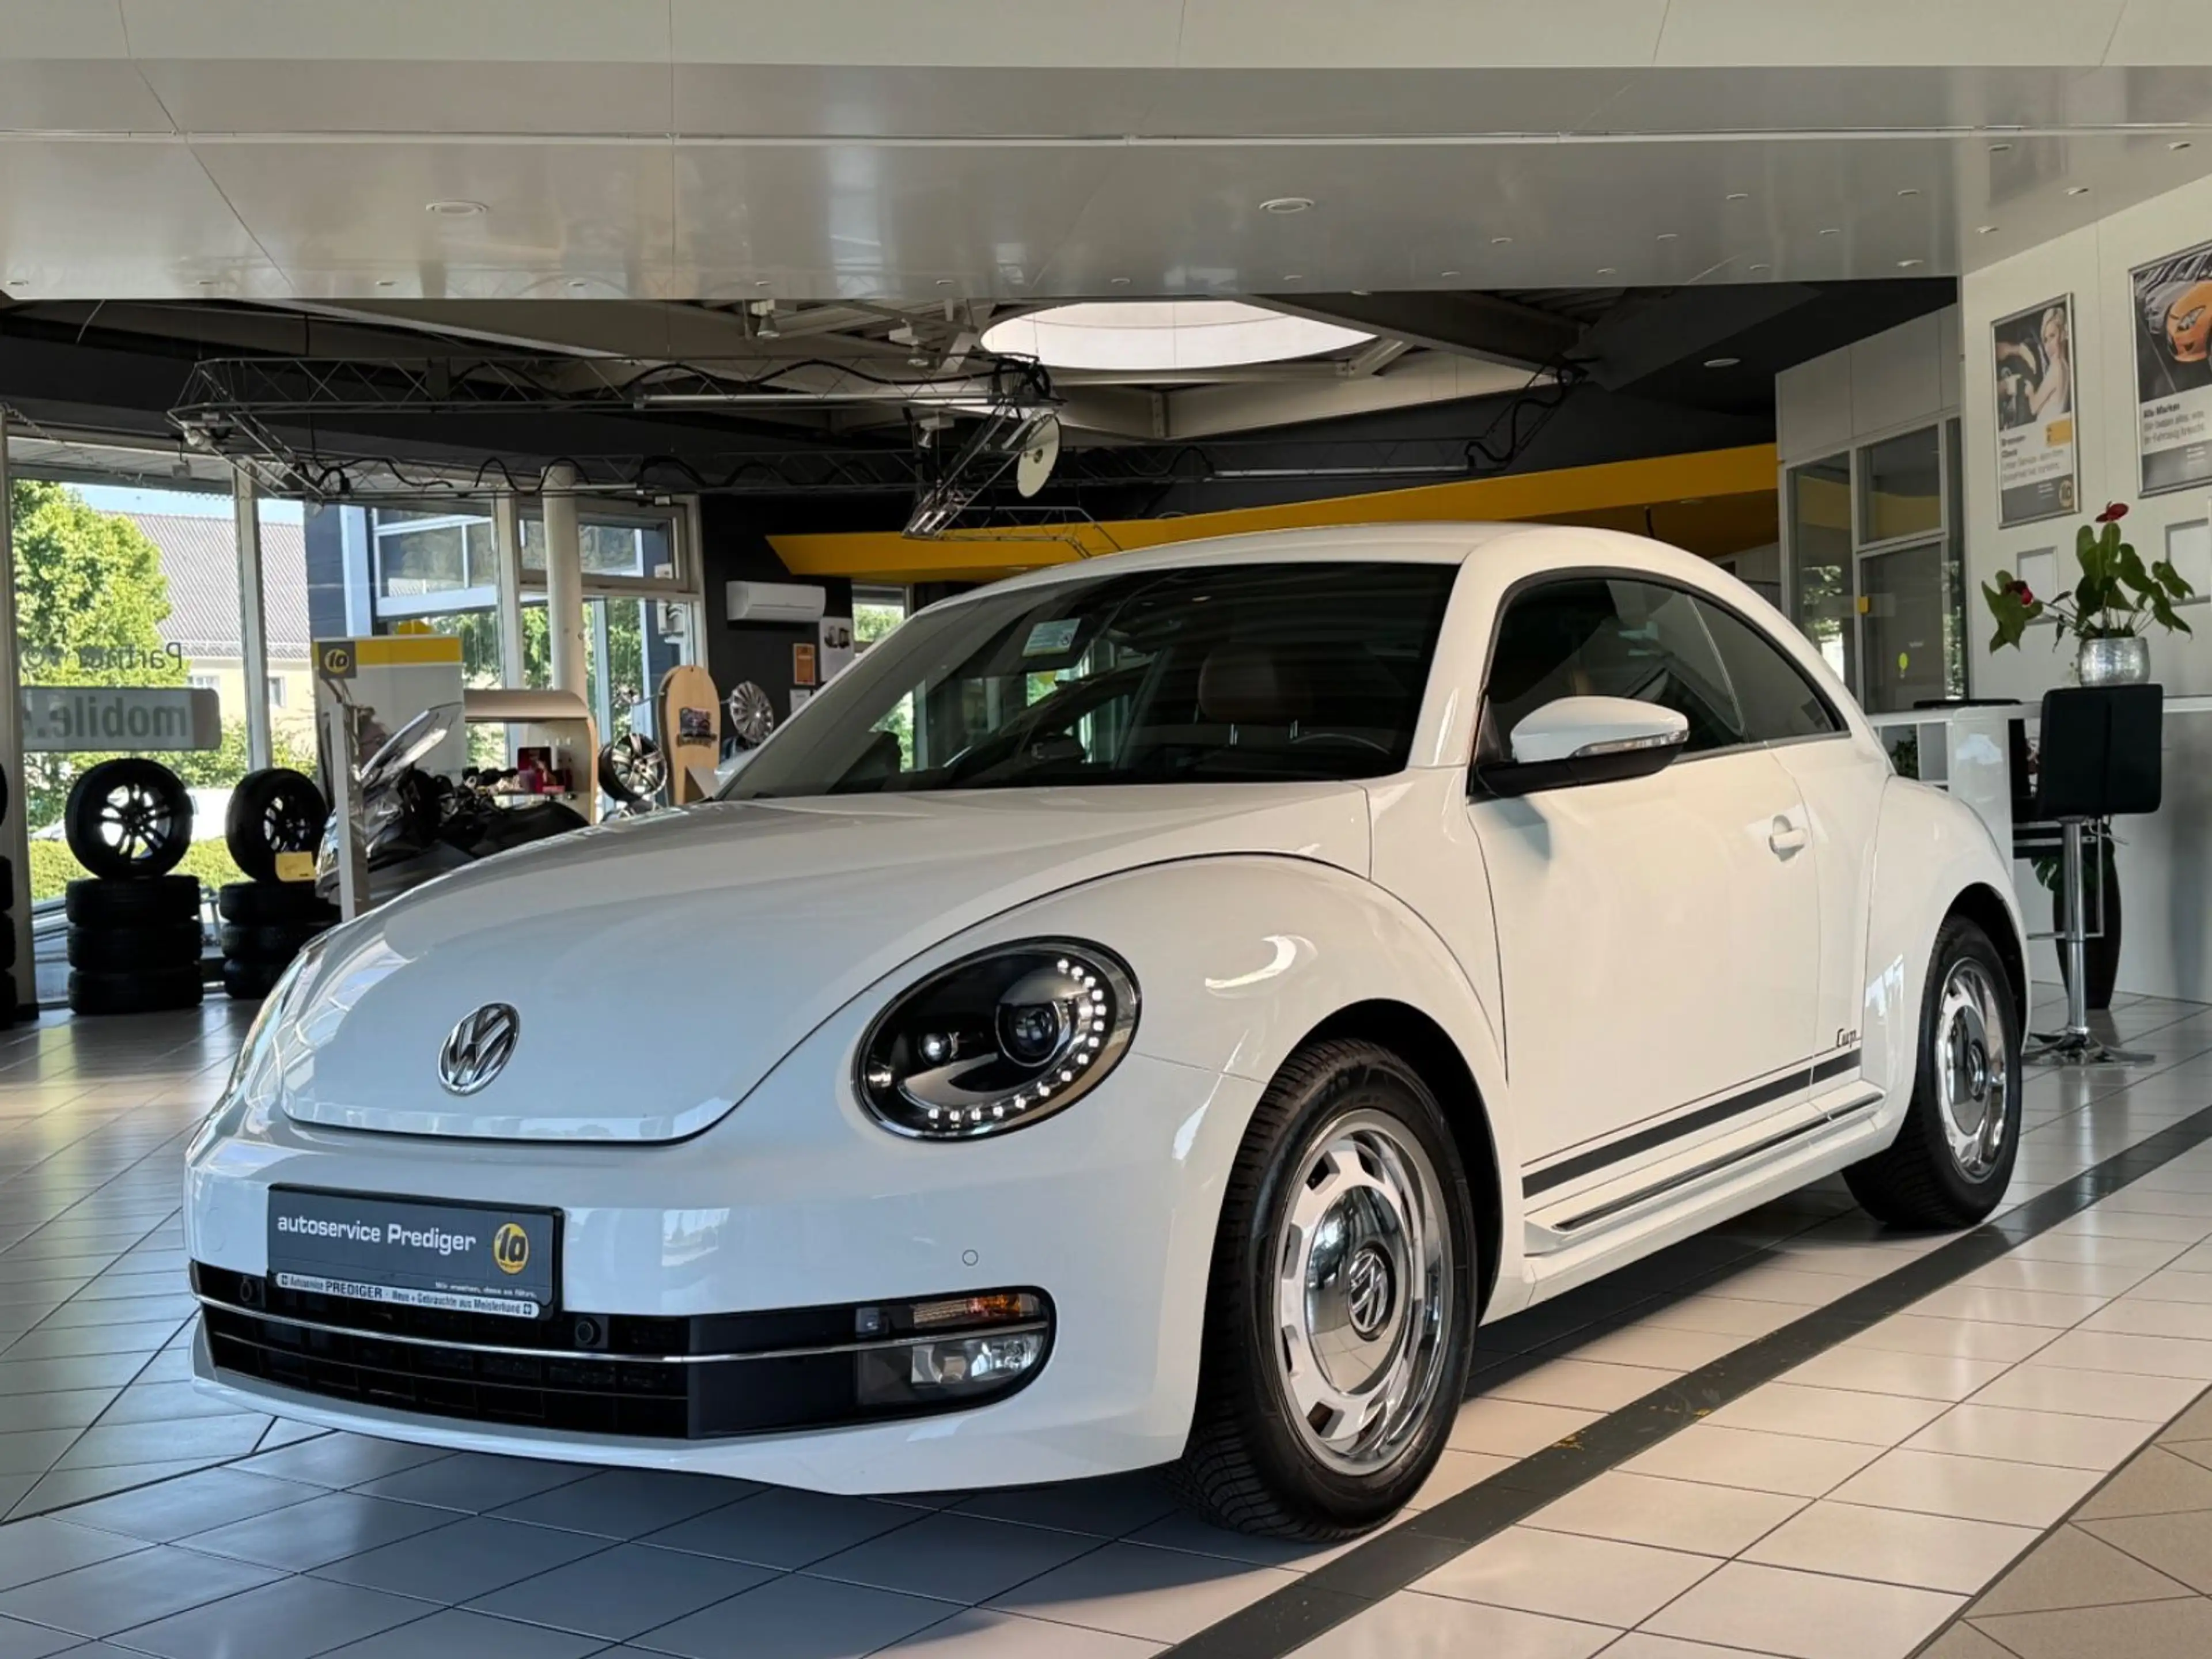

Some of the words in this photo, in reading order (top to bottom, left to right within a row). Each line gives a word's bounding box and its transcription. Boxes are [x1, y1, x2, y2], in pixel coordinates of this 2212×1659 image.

[277, 1215, 381, 1244] autoservice
[387, 1223, 477, 1256] Prediger
[325, 1279, 382, 1299] PREDIGER
